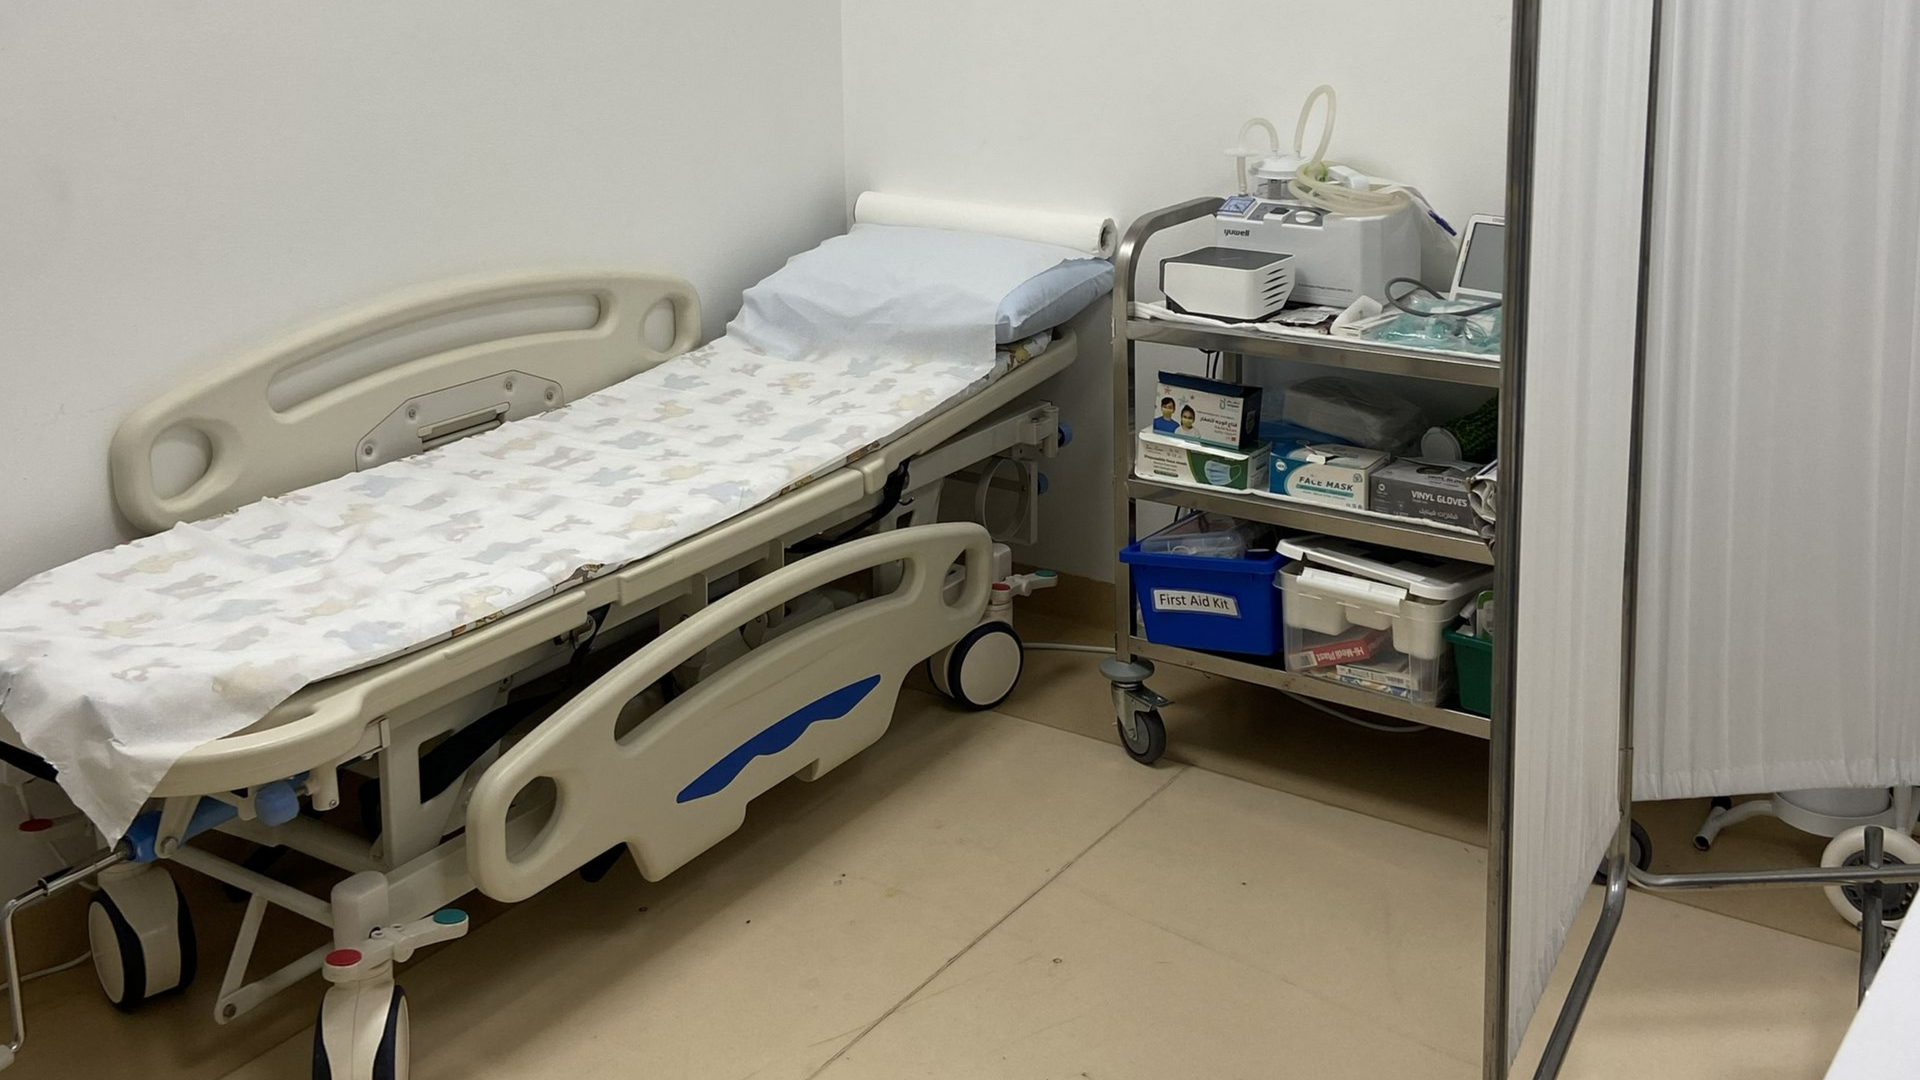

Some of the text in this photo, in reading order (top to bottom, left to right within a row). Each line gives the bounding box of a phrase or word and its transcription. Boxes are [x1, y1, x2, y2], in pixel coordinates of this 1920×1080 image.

[1223, 228, 1250, 236] yuwell
[1326, 481, 1354, 492] MASK
[1411, 490, 1435, 502] VINYL
[1437, 495, 1468, 507] GLOVES
[1160, 593, 1230, 610] First Aid Kit
